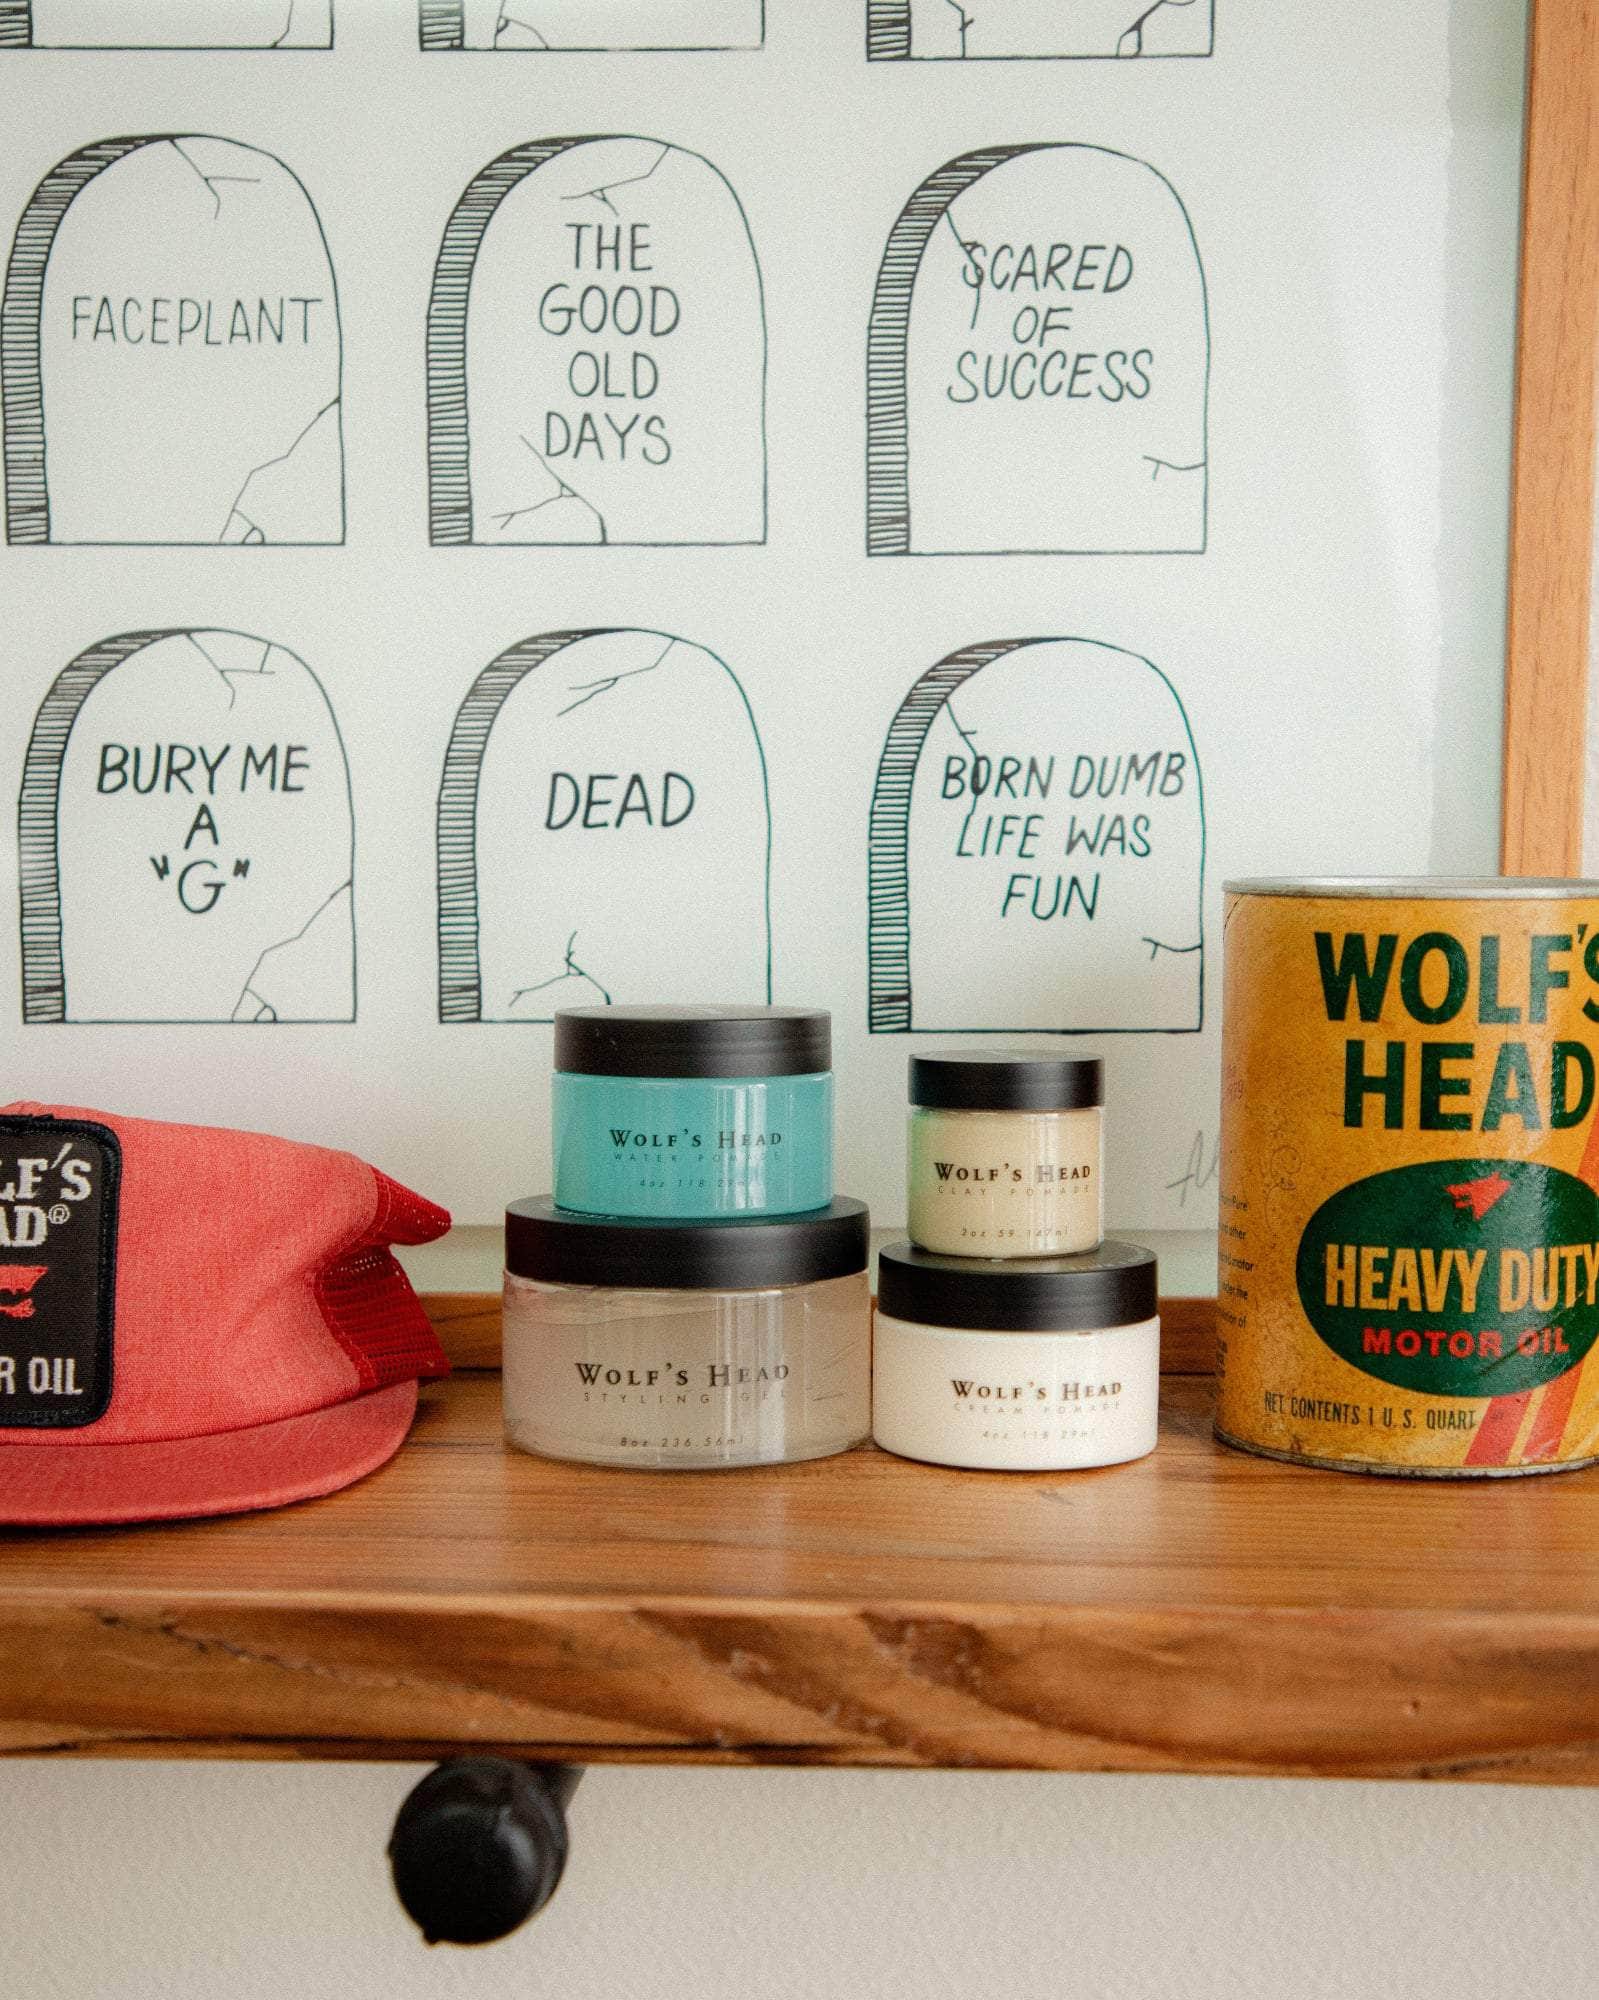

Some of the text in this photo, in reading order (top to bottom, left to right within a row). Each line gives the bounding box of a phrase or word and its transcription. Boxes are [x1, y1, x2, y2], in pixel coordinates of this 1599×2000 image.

[566, 223, 653, 272] THE
[961, 240, 1133, 294] SCARED
[73, 297, 323, 345] FACEPLANT
[539, 283, 681, 337] GOOD
[1013, 306, 1073, 347] OF
[568, 351, 659, 399] OLD
[947, 349, 1153, 403] SUCCESS
[545, 412, 672, 465] DAYS
[97, 743, 309, 795] BURY ME
[941, 751, 1186, 799] BORN DUMB
[545, 771, 695, 830] DEAD
[184, 803, 218, 850] A
[956, 814, 1151, 858] LIFE WAS
[1002, 872, 1100, 921] FUN
[1343, 1040, 1596, 1132] HEAD
[718, 1131, 782, 1149] HEAD
[1037, 1164, 1091, 1184] HEAD
[1325, 1242, 1599, 1313] HEAVY DUTY
[1362, 1326, 1570, 1359] MOTOR OIL
[28, 1357, 83, 1396] OIL
[584, 1391, 712, 1405] STYLING
[708, 1363, 790, 1388] HEAD
[1062, 1381, 1123, 1401] HEAD
[1291, 1396, 1360, 1426] CONTENTS
[1368, 1407, 1374, 1425] 1
[1426, 1409, 1477, 1431] QUART
